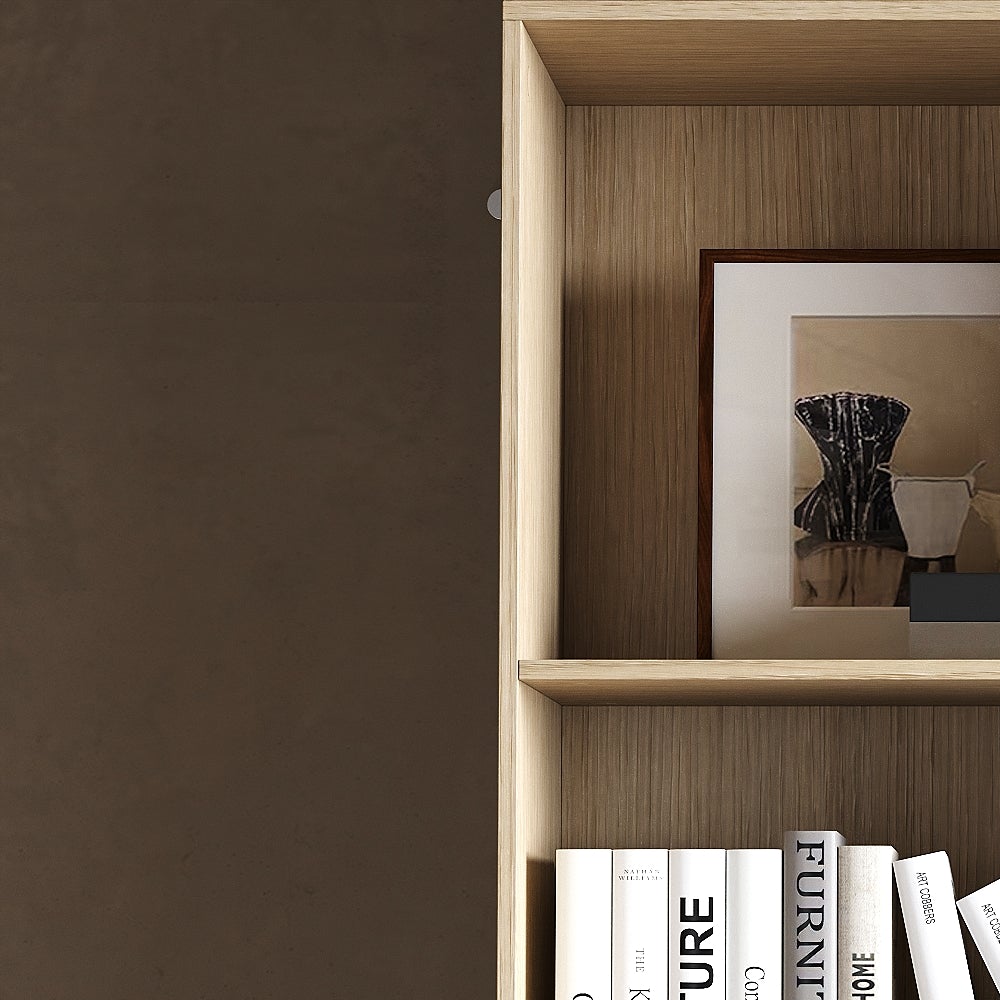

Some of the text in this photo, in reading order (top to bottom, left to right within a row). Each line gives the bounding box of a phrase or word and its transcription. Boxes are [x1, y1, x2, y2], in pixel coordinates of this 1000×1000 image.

[915, 872, 929, 886] ART
[980, 903, 997, 919] ART
[635, 947, 645, 973] THE
